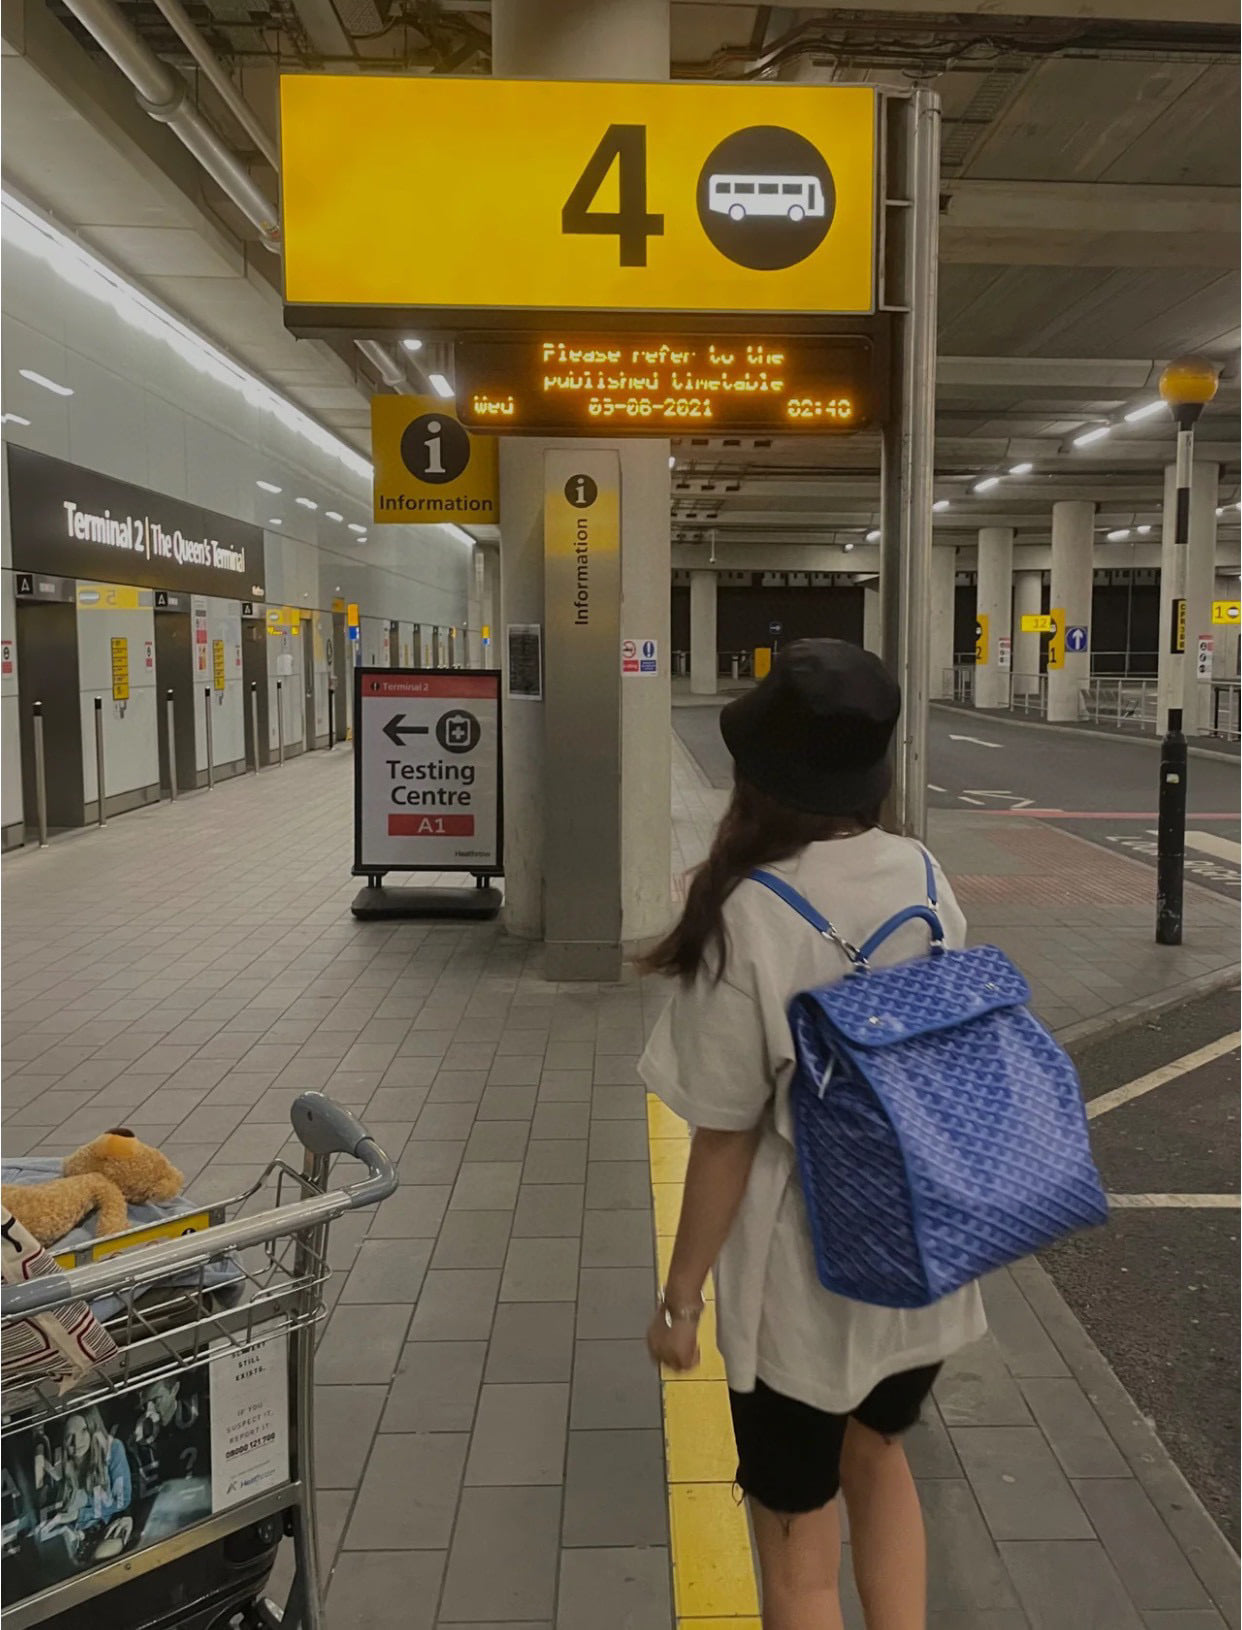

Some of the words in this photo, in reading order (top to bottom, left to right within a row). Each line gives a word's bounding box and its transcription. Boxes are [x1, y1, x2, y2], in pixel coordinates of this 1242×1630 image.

[561, 123, 665, 268] 4
[543, 342, 621, 363] Please
[632, 343, 697, 364] refer
[709, 344, 735, 365] to
[747, 345, 785, 365] the
[543, 370, 660, 392] published
[671, 371, 785, 392] timetable
[379, 494, 493, 512] Information
[63, 500, 133, 551] Terminal
[134, 519, 145, 553] 2
[150, 523, 172, 558] The
[173, 530, 211, 566] Queen's
[210, 540, 246, 573] Terminal
[573, 517, 590, 626] Information
[382, 682, 423, 692] Terminal
[423, 683, 429, 692] 2
[385, 760, 475, 785] Testing
[391, 786, 472, 806] Centre
[418, 817, 446, 834] A1
[238, 1355, 260, 1369] STILL
[226, 1413, 262, 1434] SUSPECT
[229, 1425, 260, 1444] REPORT
